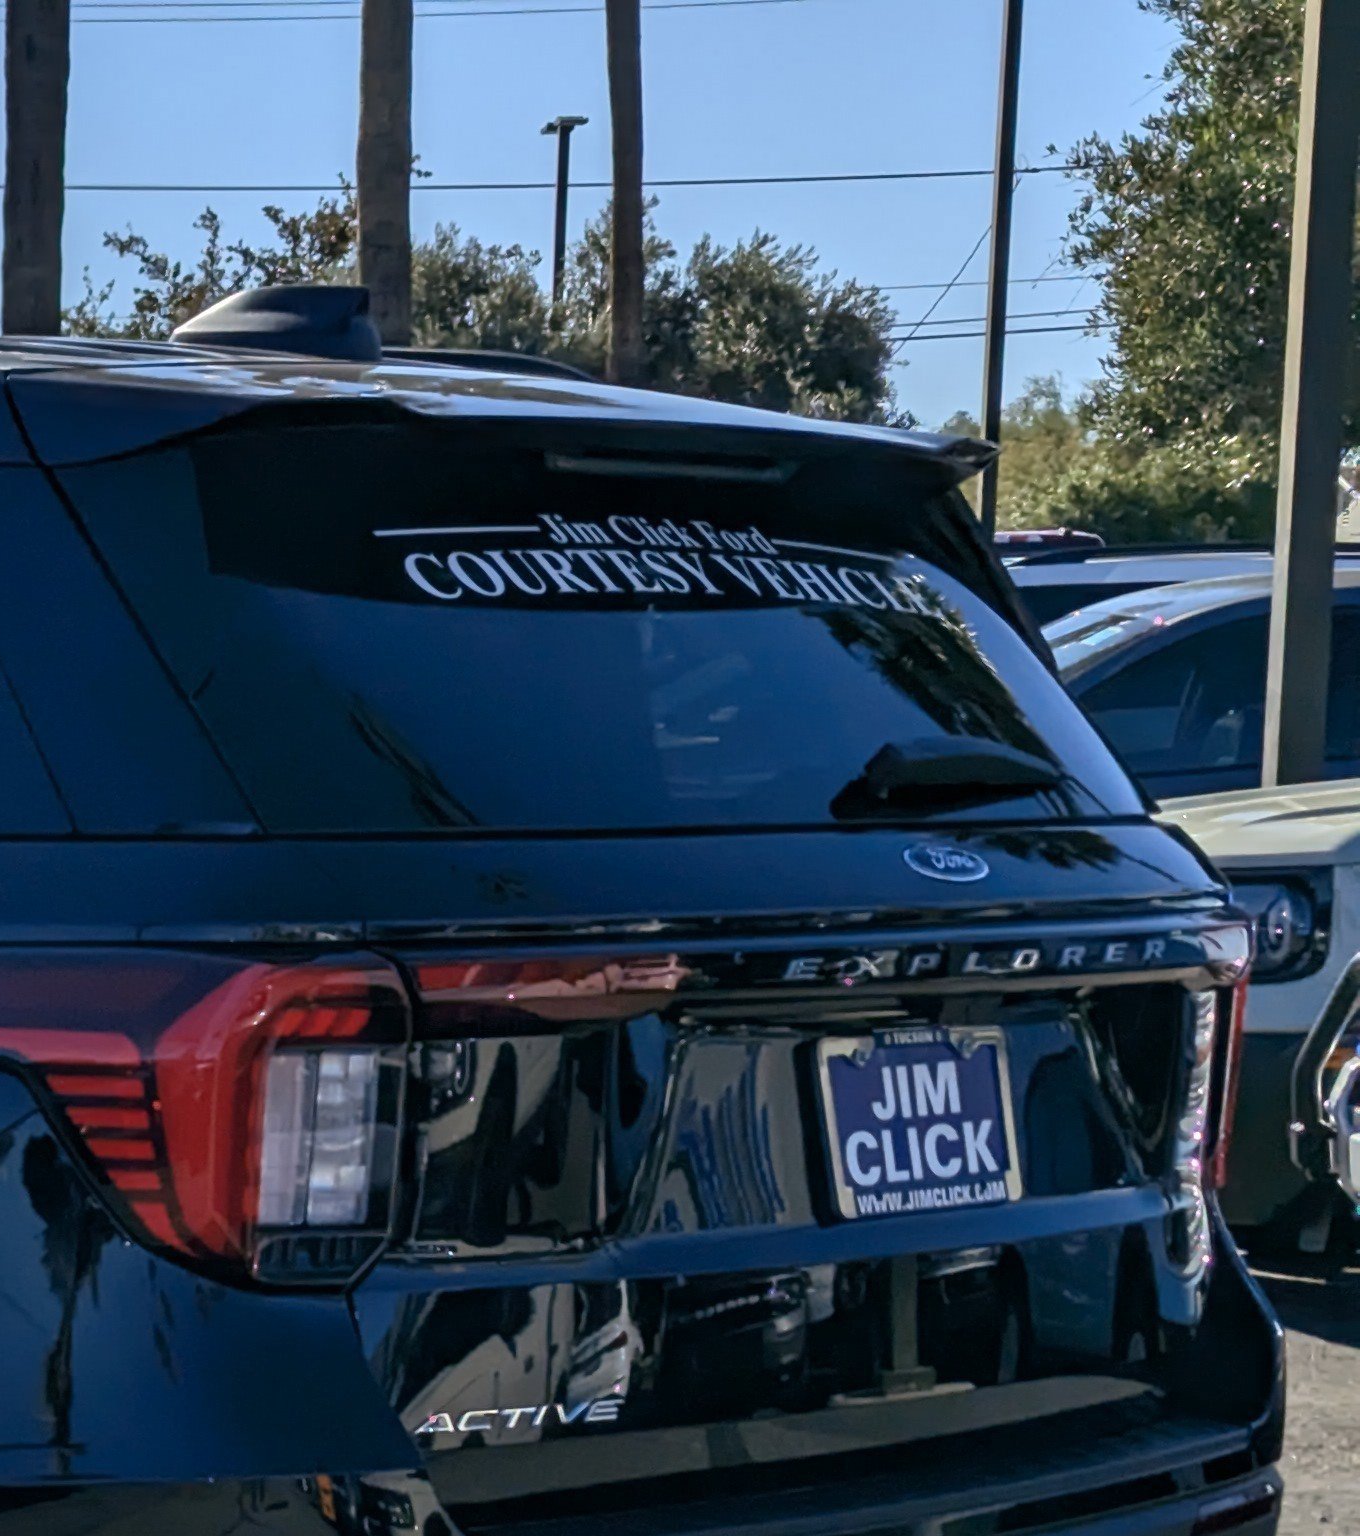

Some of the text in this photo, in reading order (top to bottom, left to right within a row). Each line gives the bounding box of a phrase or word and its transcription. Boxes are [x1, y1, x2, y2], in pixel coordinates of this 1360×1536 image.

[538, 513, 780, 555] Jim Click Ford
[404, 549, 724, 600] COURTESY
[783, 938, 1166, 980] EXPLORER
[872, 1061, 962, 1120] JIM
[846, 1119, 999, 1187] CLICK
[415, 1399, 625, 1434] ACTIVE
